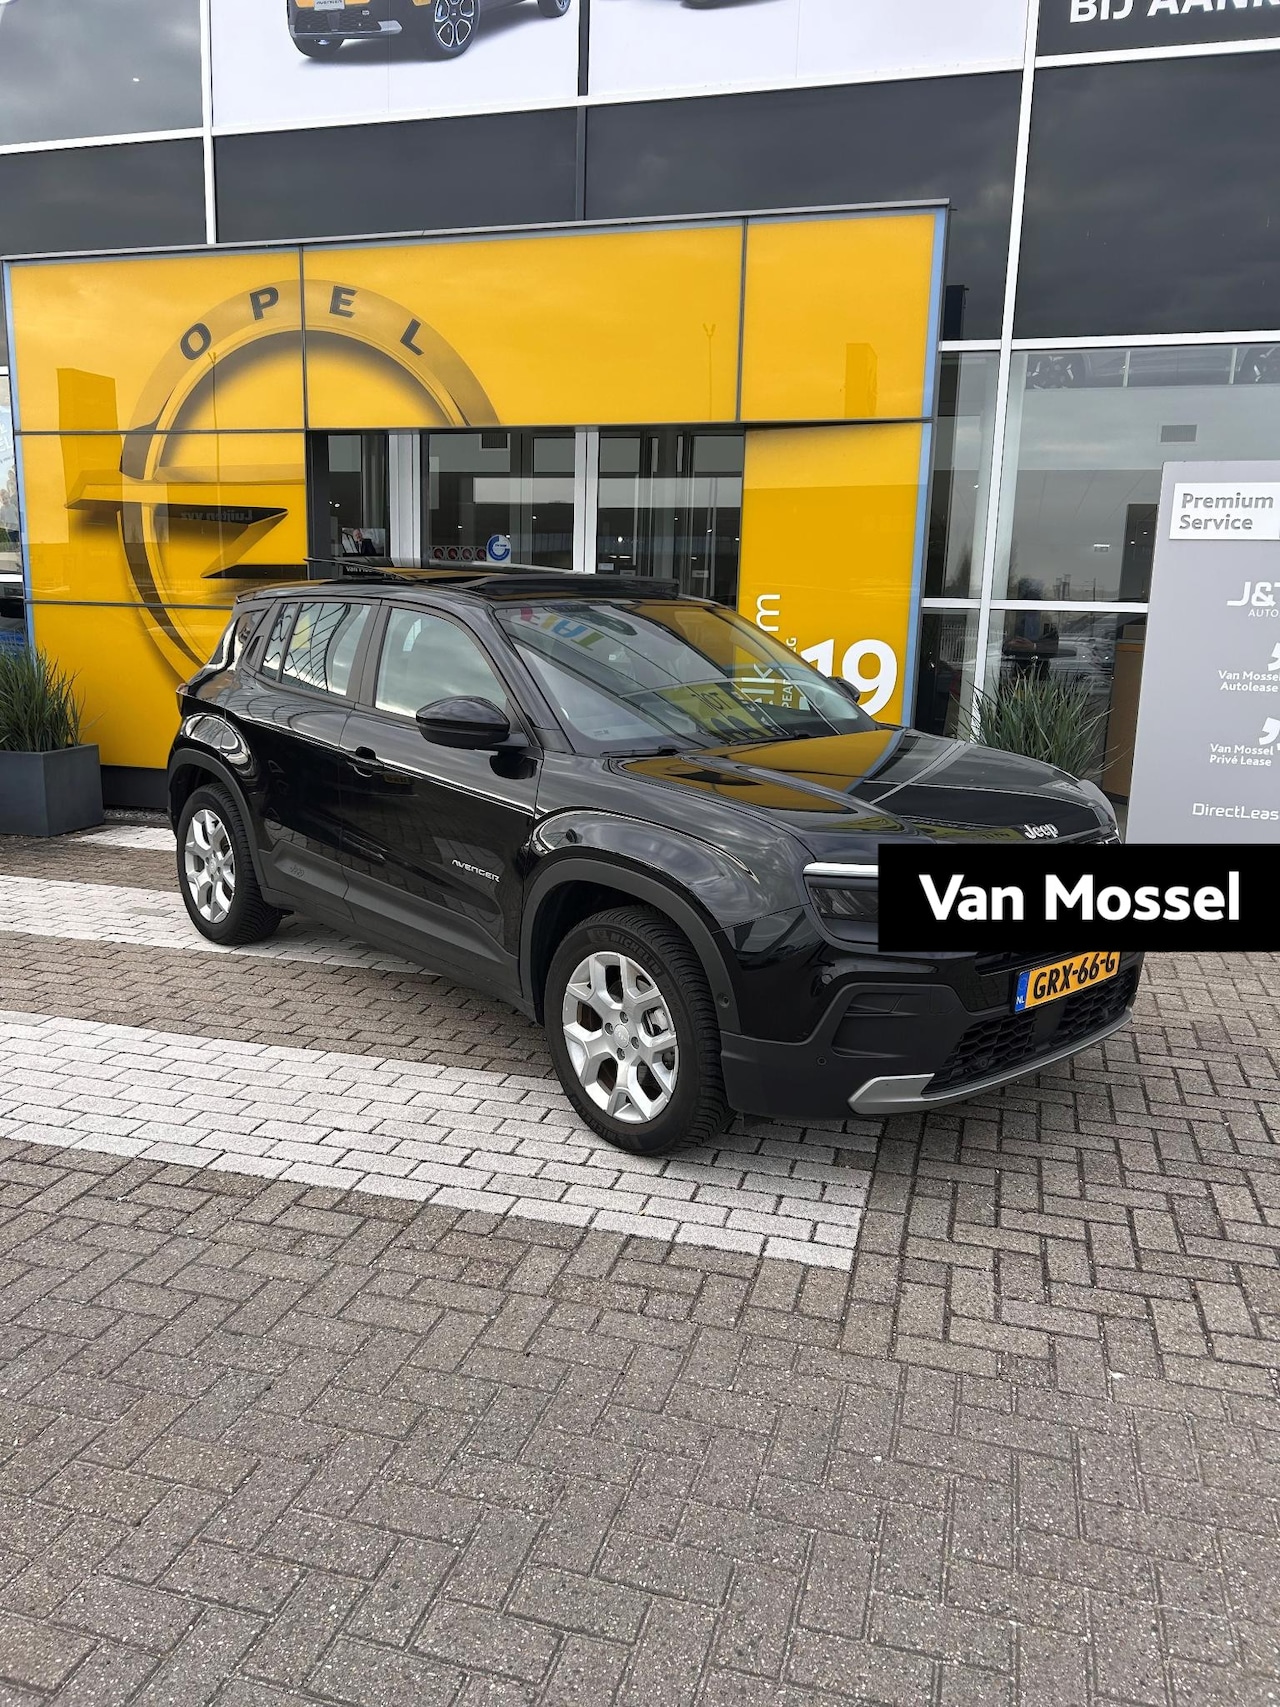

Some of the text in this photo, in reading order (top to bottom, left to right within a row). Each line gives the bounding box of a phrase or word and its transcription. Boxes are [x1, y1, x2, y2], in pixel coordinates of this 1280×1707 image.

[179, 285, 425, 361] OPEL
[1181, 492, 1275, 509] Premium
[1179, 514, 1254, 531] Service
[1248, 609, 1279, 618] AUTO
[800, 638, 898, 718] 19
[1218, 670, 1240, 681] Van
[1219, 681, 1279, 692] Autolease
[1210, 743, 1274, 756] Van Mossel
[1209, 754, 1272, 767] Privé Lease
[1023, 823, 1059, 839] Jeep
[451, 859, 501, 883] AVENGER
[1032, 951, 1116, 1000] GRX-66-G
[1016, 996, 1025, 1005] NL
